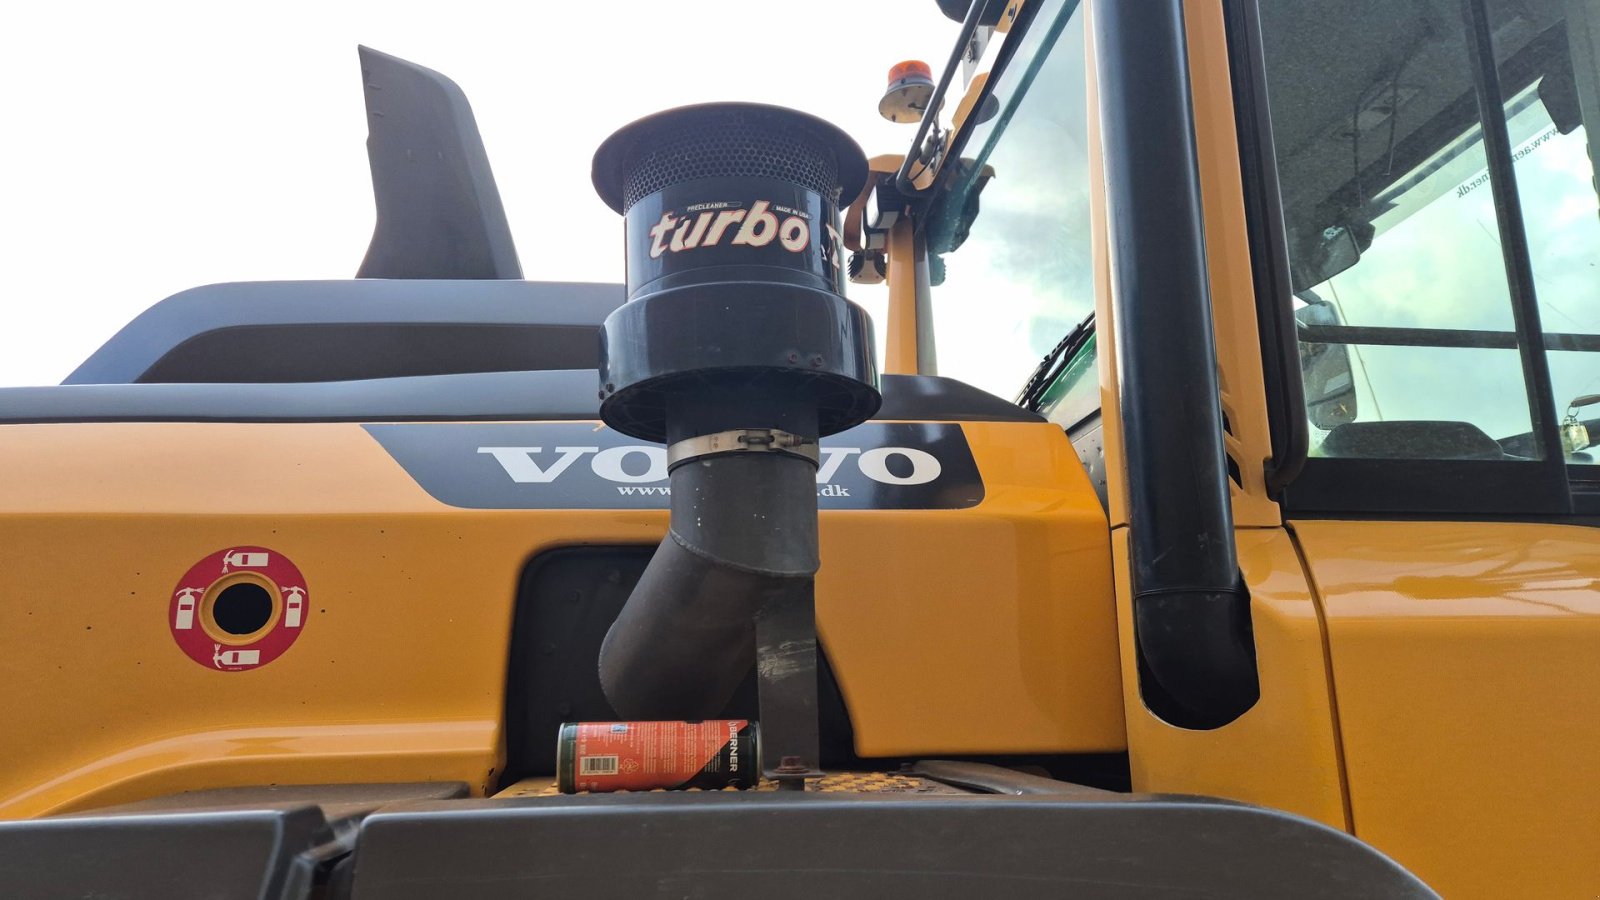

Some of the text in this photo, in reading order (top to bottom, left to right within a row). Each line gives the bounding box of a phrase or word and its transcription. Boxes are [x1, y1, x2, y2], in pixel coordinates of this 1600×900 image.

[686, 202, 728, 211] PRECLEANER
[776, 205, 791, 213] MADE
[799, 210, 809, 219] USA
[649, 200, 810, 259] turbo
[477, 446, 942, 486] VOO
[728, 726, 739, 772] BERNER
